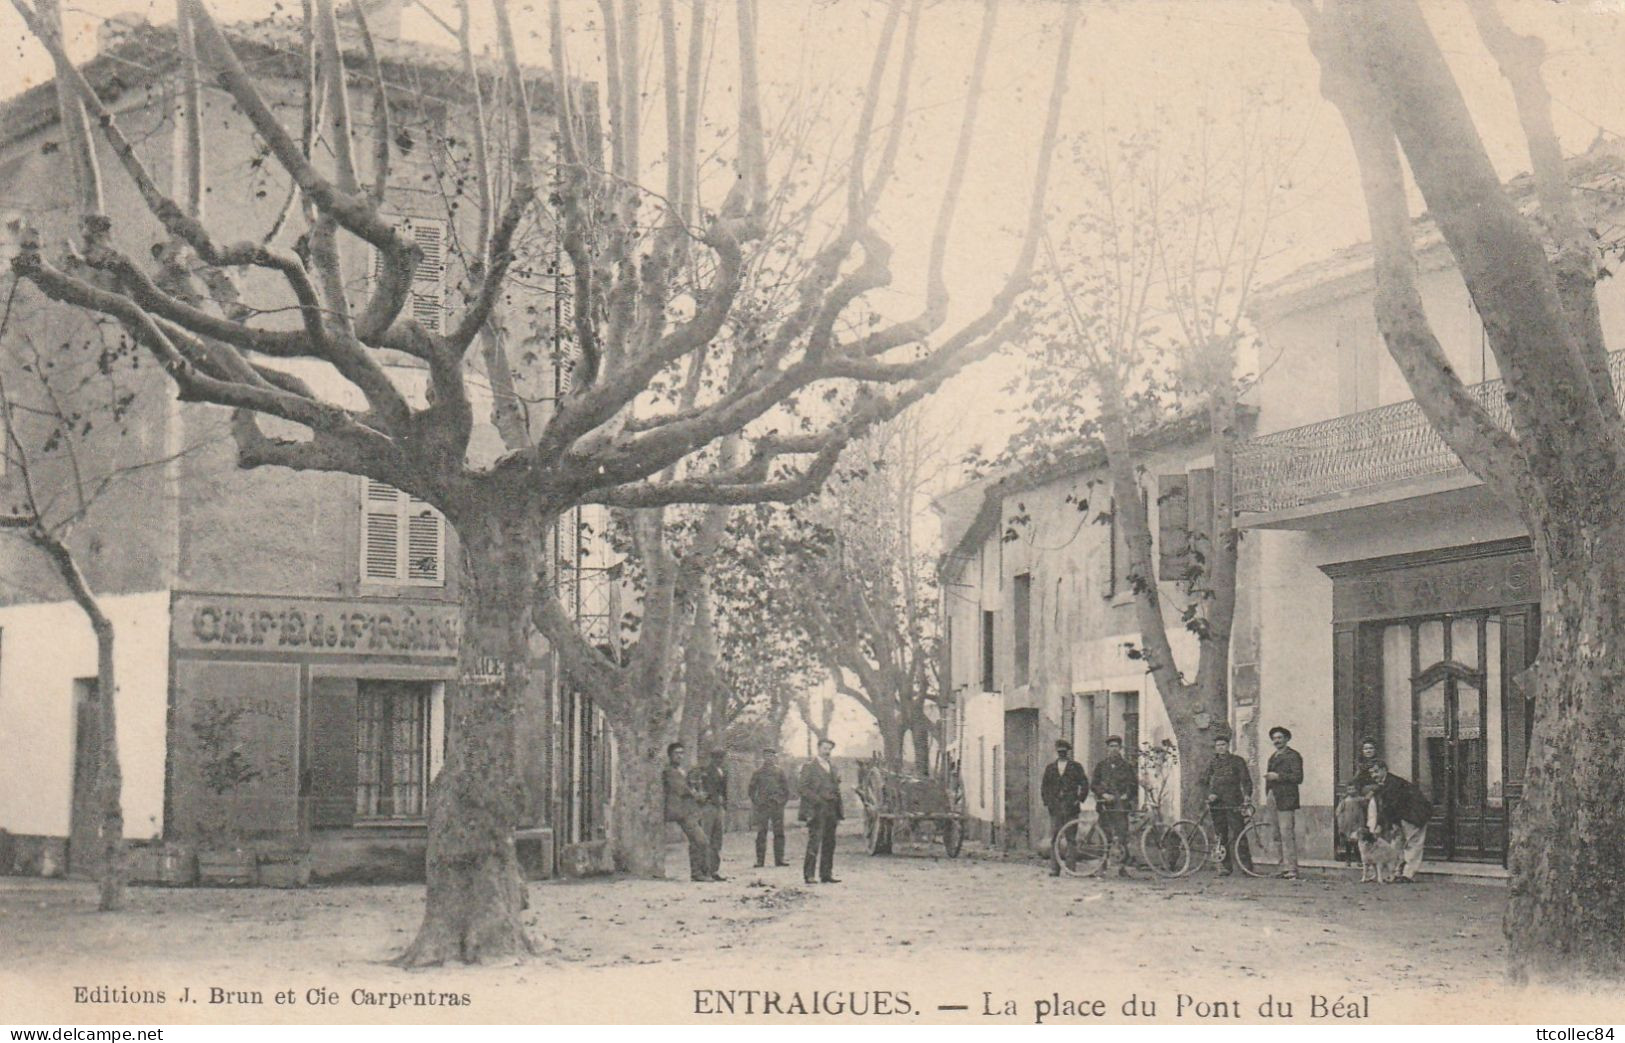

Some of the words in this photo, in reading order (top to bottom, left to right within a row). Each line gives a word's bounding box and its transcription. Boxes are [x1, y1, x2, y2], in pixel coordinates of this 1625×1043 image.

[73, 986, 166, 1004] Editions
[179, 987, 197, 1004] J.
[208, 987, 264, 1005] Brun
[274, 989, 296, 1005] et
[306, 987, 340, 1005] Cie
[351, 988, 472, 1009] Carpentras
[693, 989, 921, 1016] ENTRAIGUES.
[982, 991, 1018, 1016] La
[1034, 992, 1107, 1024] place
[1121, 993, 1157, 1017] du
[1176, 994, 1242, 1018] Pont
[1258, 994, 1294, 1018] du
[1310, 995, 1370, 1018] Béal
